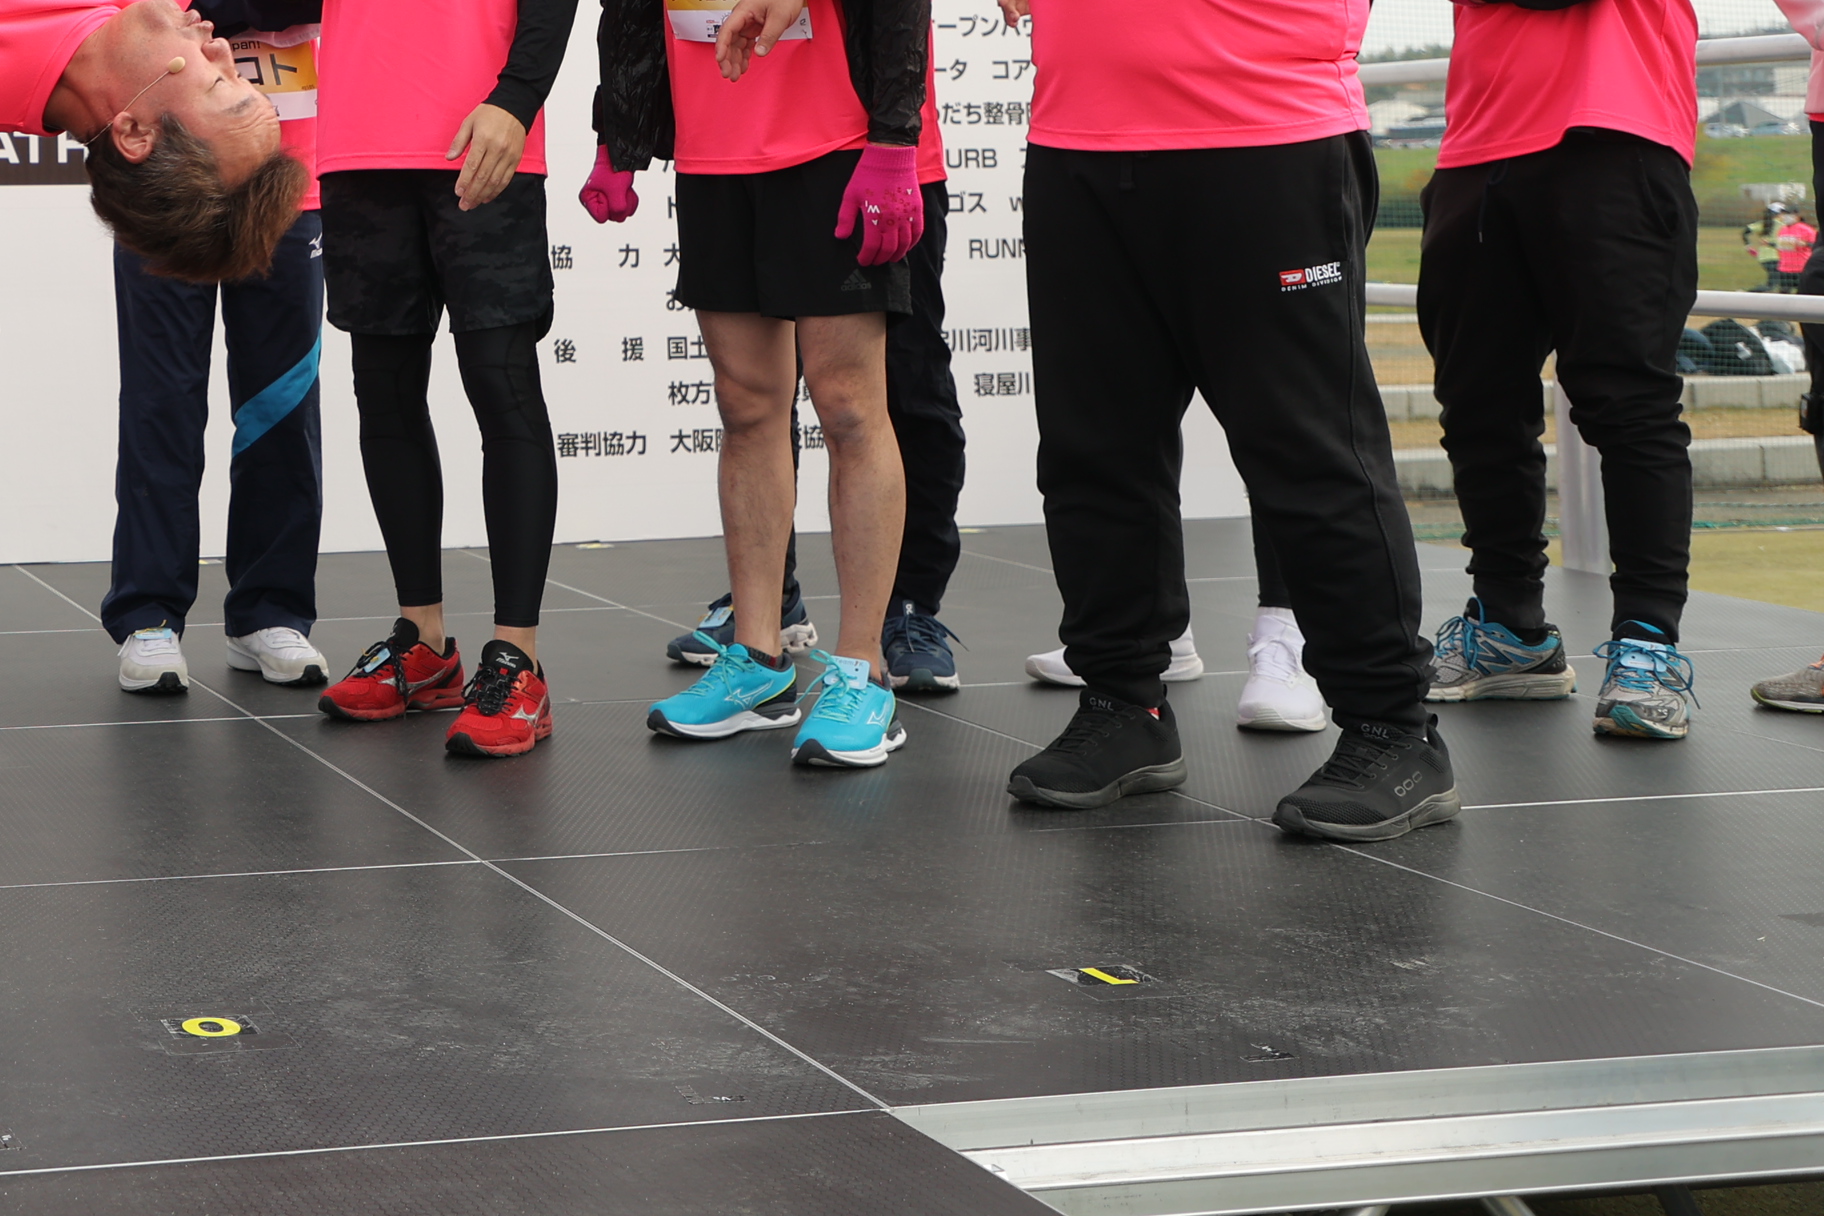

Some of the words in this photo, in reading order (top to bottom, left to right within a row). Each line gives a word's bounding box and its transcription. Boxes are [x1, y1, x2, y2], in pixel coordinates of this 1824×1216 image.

[234, 53, 298, 86] コト
[935, 58, 967, 81] ータ
[937, 101, 1031, 126] だち整骨
[1304, 262, 1341, 283] DIESEL
[666, 335, 709, 361] 国土
[941, 327, 1033, 353] 川河川事
[668, 380, 718, 406] 枚方
[974, 371, 1030, 397] 寝屋川
[557, 431, 647, 459] 審判協力
[670, 428, 725, 454] 大阪
[1089, 696, 1114, 711] GNL
[1361, 723, 1390, 739] GNL
